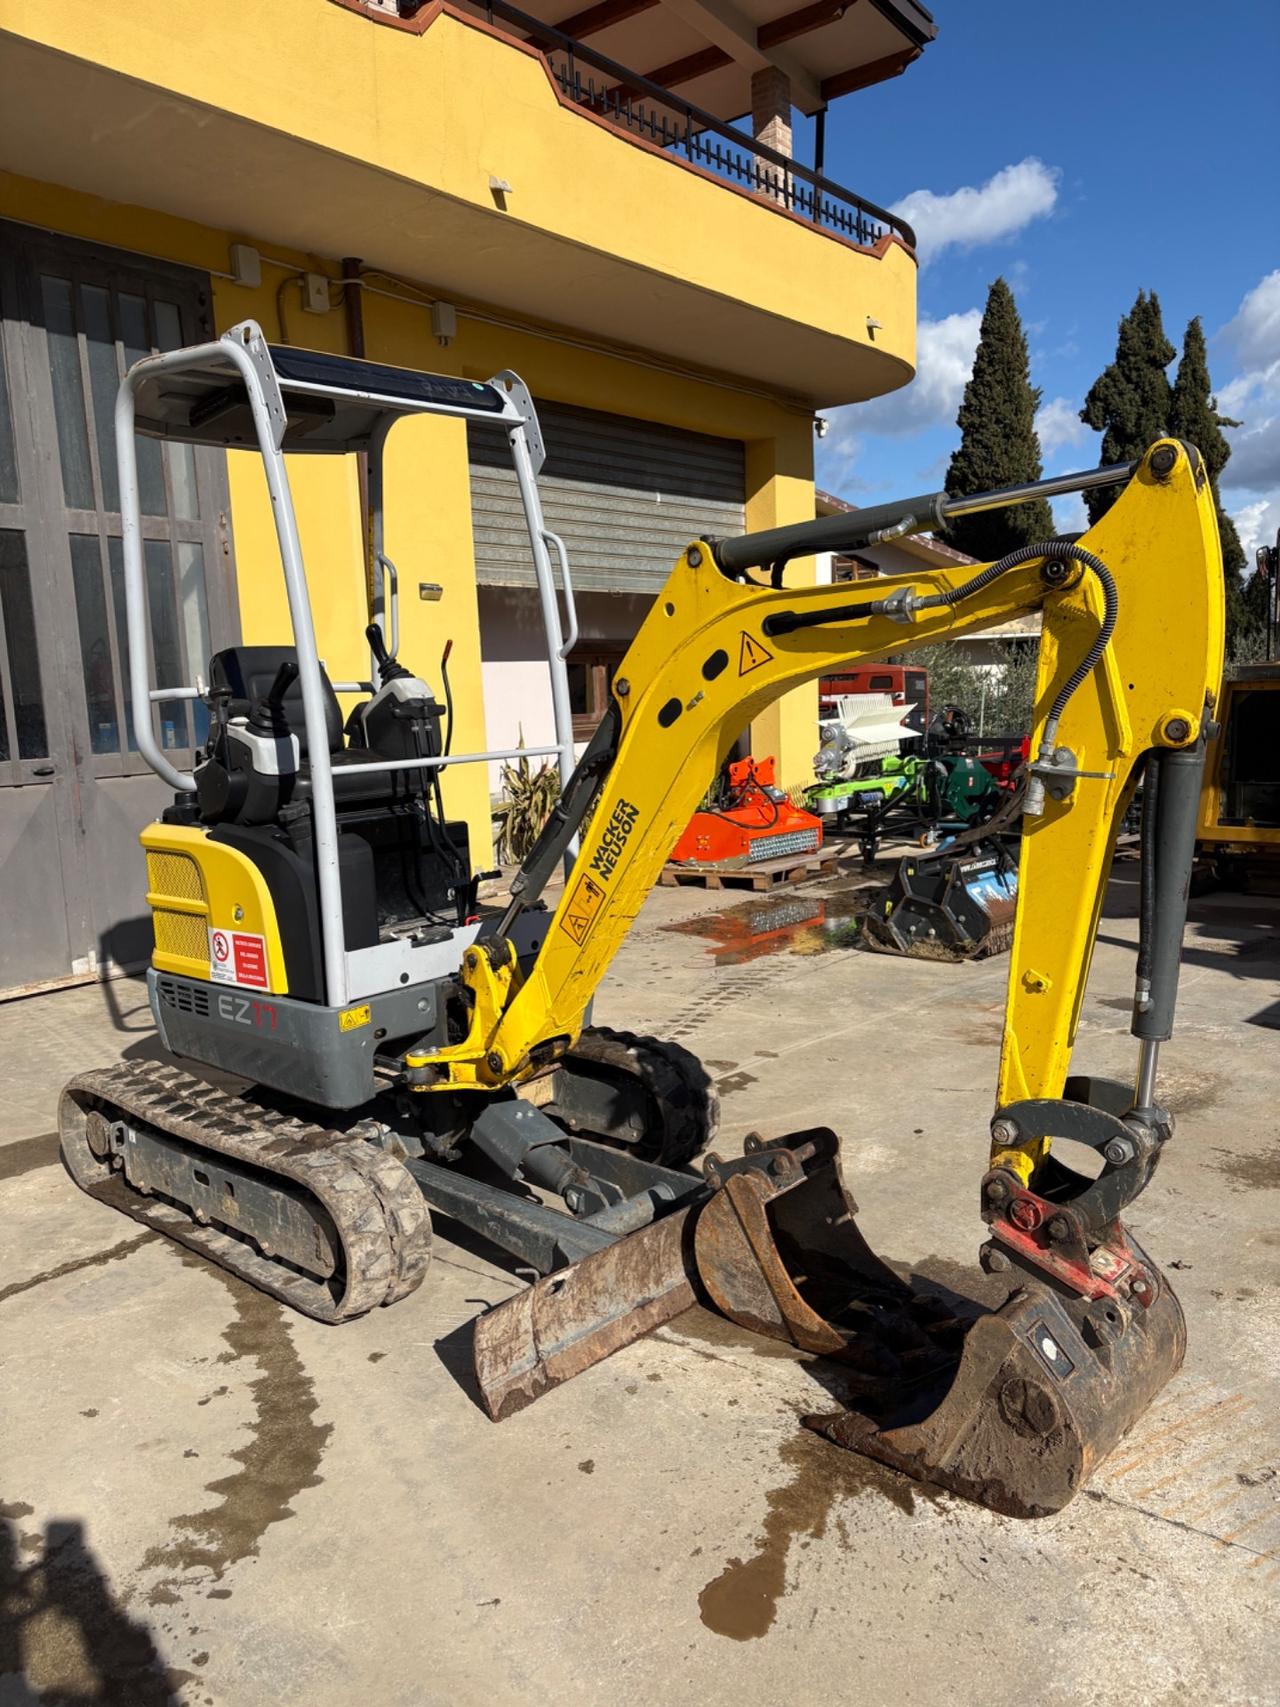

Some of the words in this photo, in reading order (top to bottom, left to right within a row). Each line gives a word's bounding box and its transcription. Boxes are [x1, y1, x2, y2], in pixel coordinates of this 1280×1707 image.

[589, 798, 630, 870] WACKER
[599, 804, 640, 881] NEUSON
[218, 994, 277, 1032] EZ17
